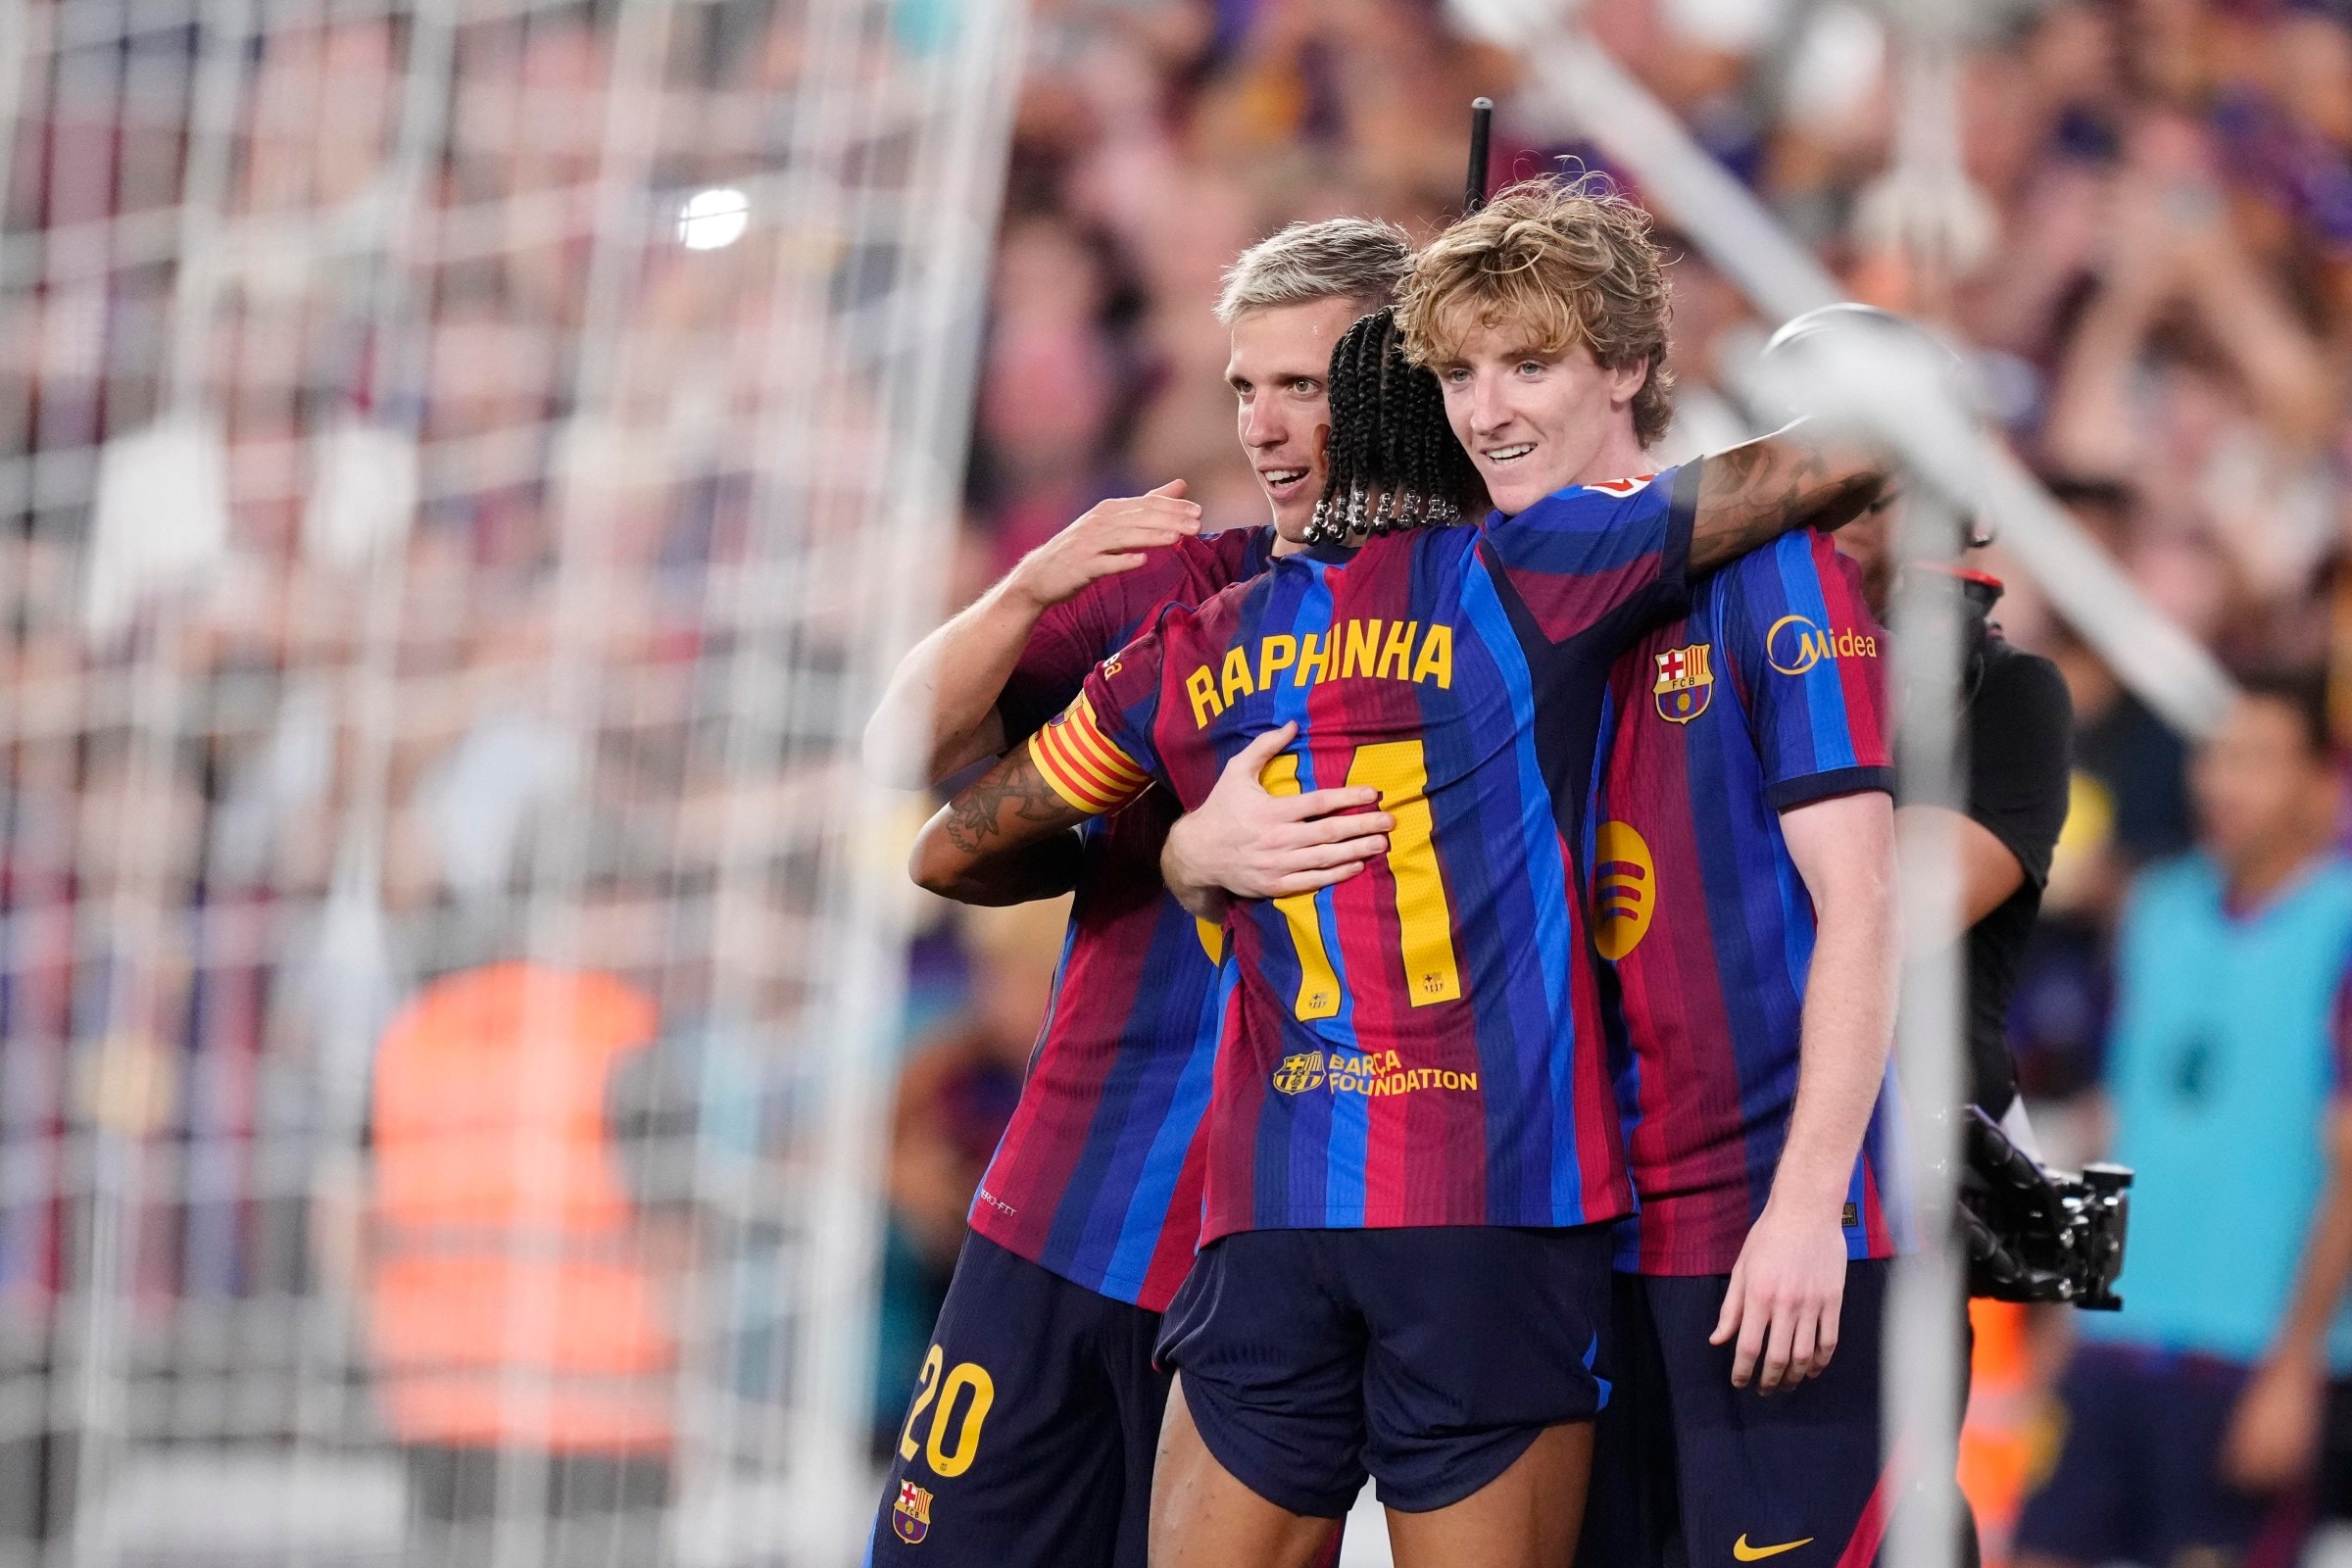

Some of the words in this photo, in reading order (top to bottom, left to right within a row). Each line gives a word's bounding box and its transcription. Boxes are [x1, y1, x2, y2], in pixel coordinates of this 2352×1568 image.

[1185, 618, 1452, 730] RAPHINHA
[1781, 627, 1878, 674] Midea
[1257, 739, 1461, 1023] 11
[1328, 1049, 1402, 1078] BARÇA
[1328, 1067, 1478, 1098] FOUNDATION
[899, 1343, 995, 1478] 20
